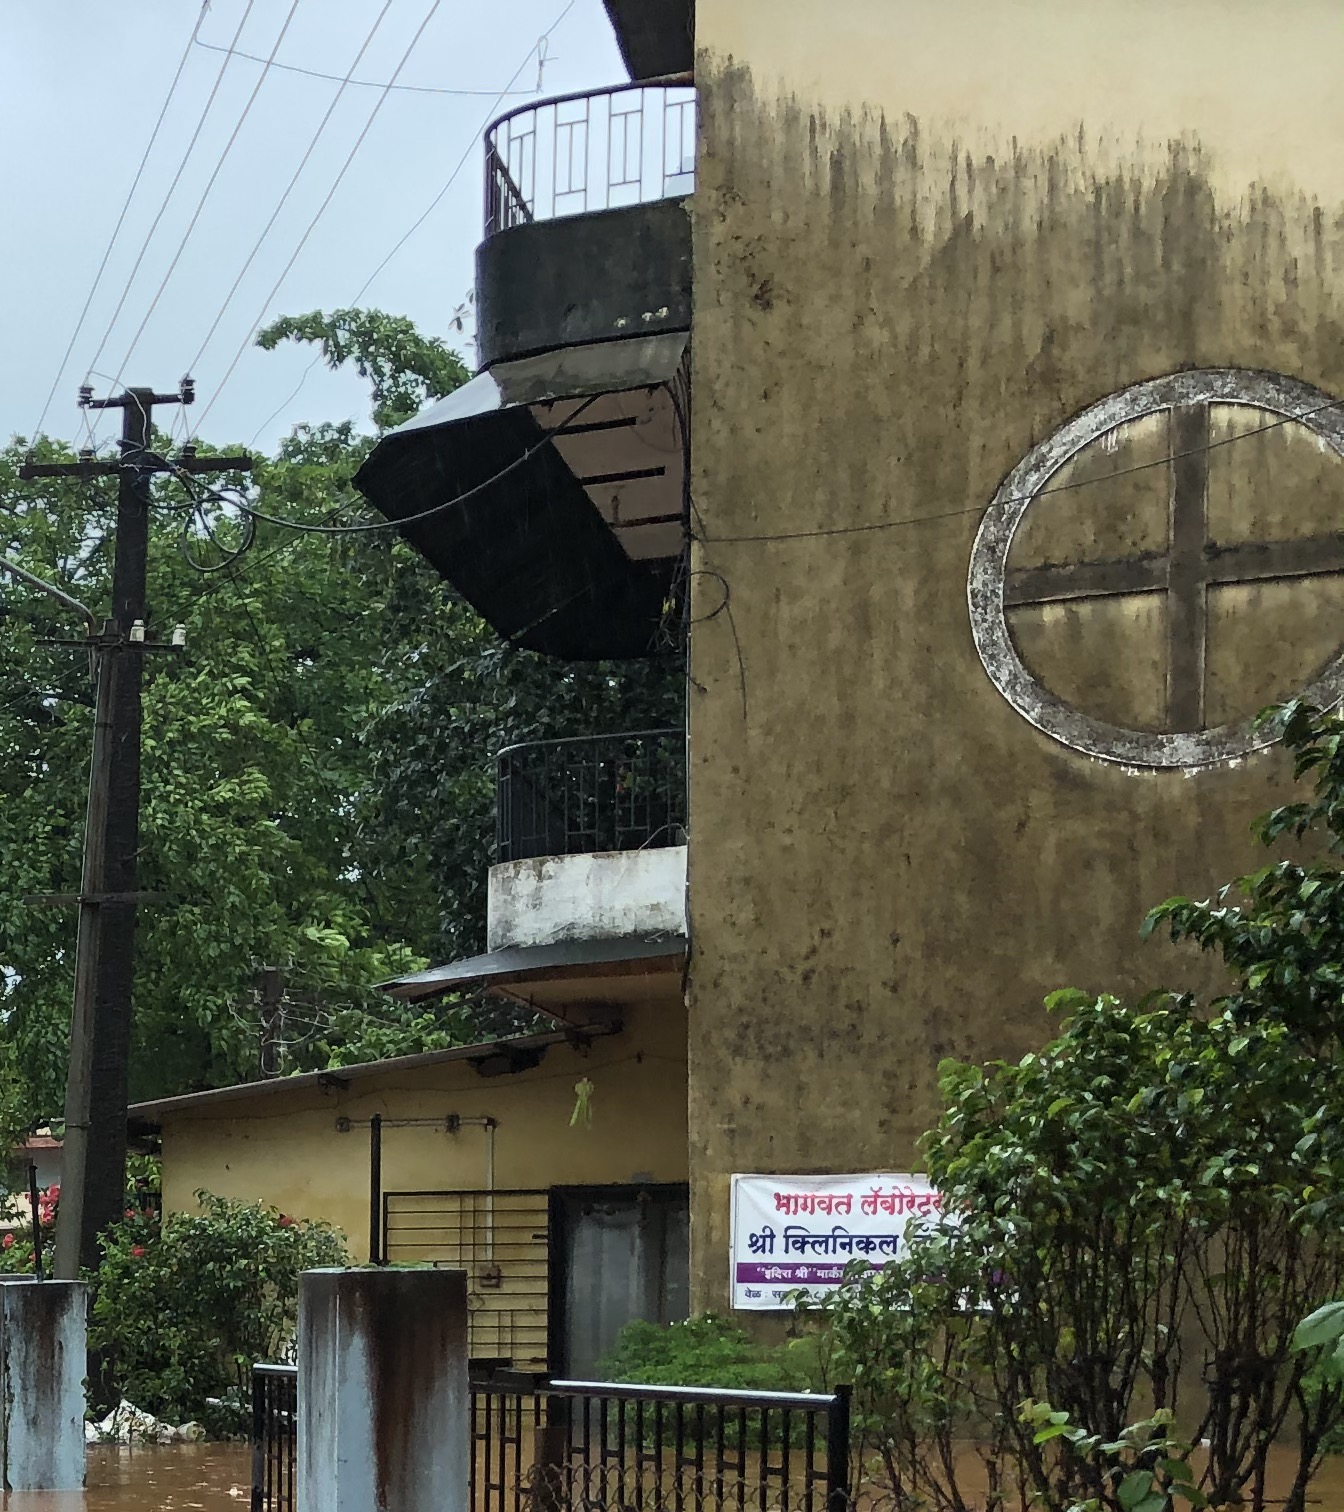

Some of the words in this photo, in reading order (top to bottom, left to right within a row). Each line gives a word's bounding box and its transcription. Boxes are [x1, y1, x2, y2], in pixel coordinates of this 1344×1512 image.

[774, 1192, 853, 1215] भागवत
[747, 1225, 775, 1255] श्री
[783, 1225, 899, 1255] क्लिनिकल
